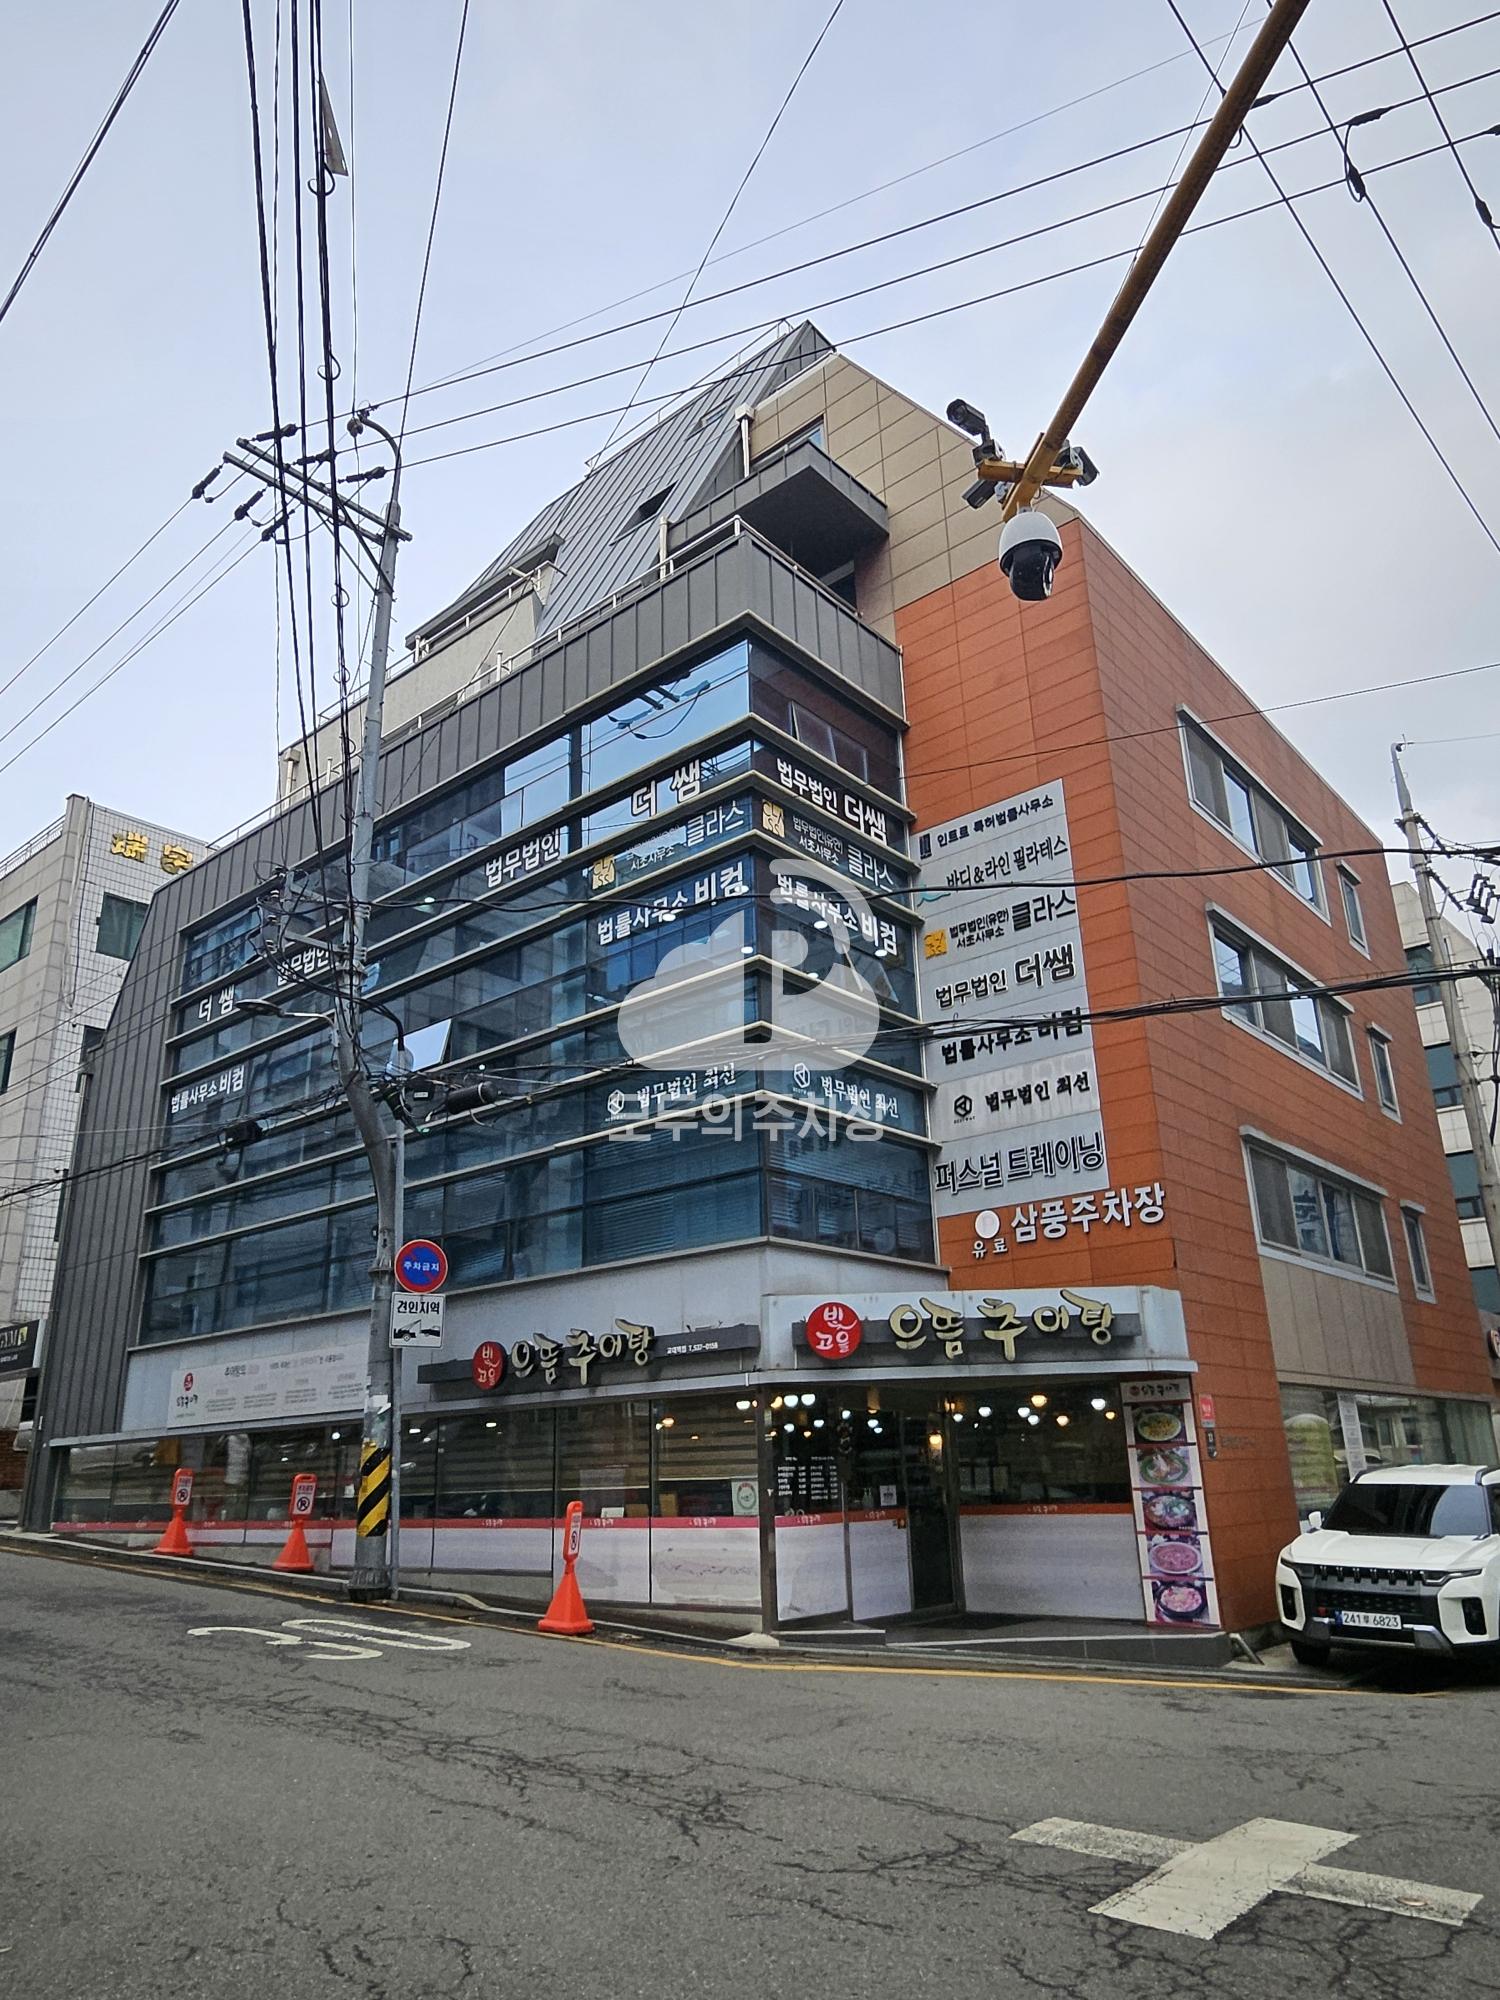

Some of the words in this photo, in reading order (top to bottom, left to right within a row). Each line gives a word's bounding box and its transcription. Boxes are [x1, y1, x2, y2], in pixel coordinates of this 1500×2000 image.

[687, 800, 745, 848] 클라스
[777, 758, 838, 815] 법무법인
[844, 794, 888, 846] 더쌤
[973, 795, 1054, 832] 특허법률사무소
[485, 830, 562, 888] 법무법인
[848, 844, 894, 894] 클라스
[946, 852, 1011, 890] 바디&라인
[1013, 835, 1069, 872] 필라테스
[597, 890, 689, 946] 법률사무소
[694, 861, 744, 905] 비컴
[777, 873, 859, 932] 법률사무소
[862, 912, 898, 956] 비컴
[1011, 889, 1077, 932] 클라스
[956, 926, 1005, 949] 서초사무소
[935, 968, 1008, 1009] 법무법인
[1014, 943, 1077, 989] 더쌤
[198, 994, 213, 1023] 더
[941, 1027, 1033, 1065] 법률사무소
[171, 1081, 218, 1114] 법률사무소
[219, 1064, 245, 1095] 비컴
[636, 1072, 697, 1108] 법무법인
[702, 1062, 737, 1089] 최선
[820, 1075, 871, 1110] 법무법인
[985, 1080, 1051, 1113] 법무법인
[1056, 1071, 1091, 1098] 최선
[935, 1149, 1003, 1195] 퍼스널
[1006, 1131, 1105, 1181] 트레이닝
[1010, 1181, 1166, 1243] 삼풍주차장
[403, 1261, 440, 1272] 주차금지
[971, 1237, 1009, 1260] 유료
[396, 1300, 441, 1315] 견인지역
[823, 1305, 858, 1331] 빛
[1372, 1615, 1399, 1628] 6823
